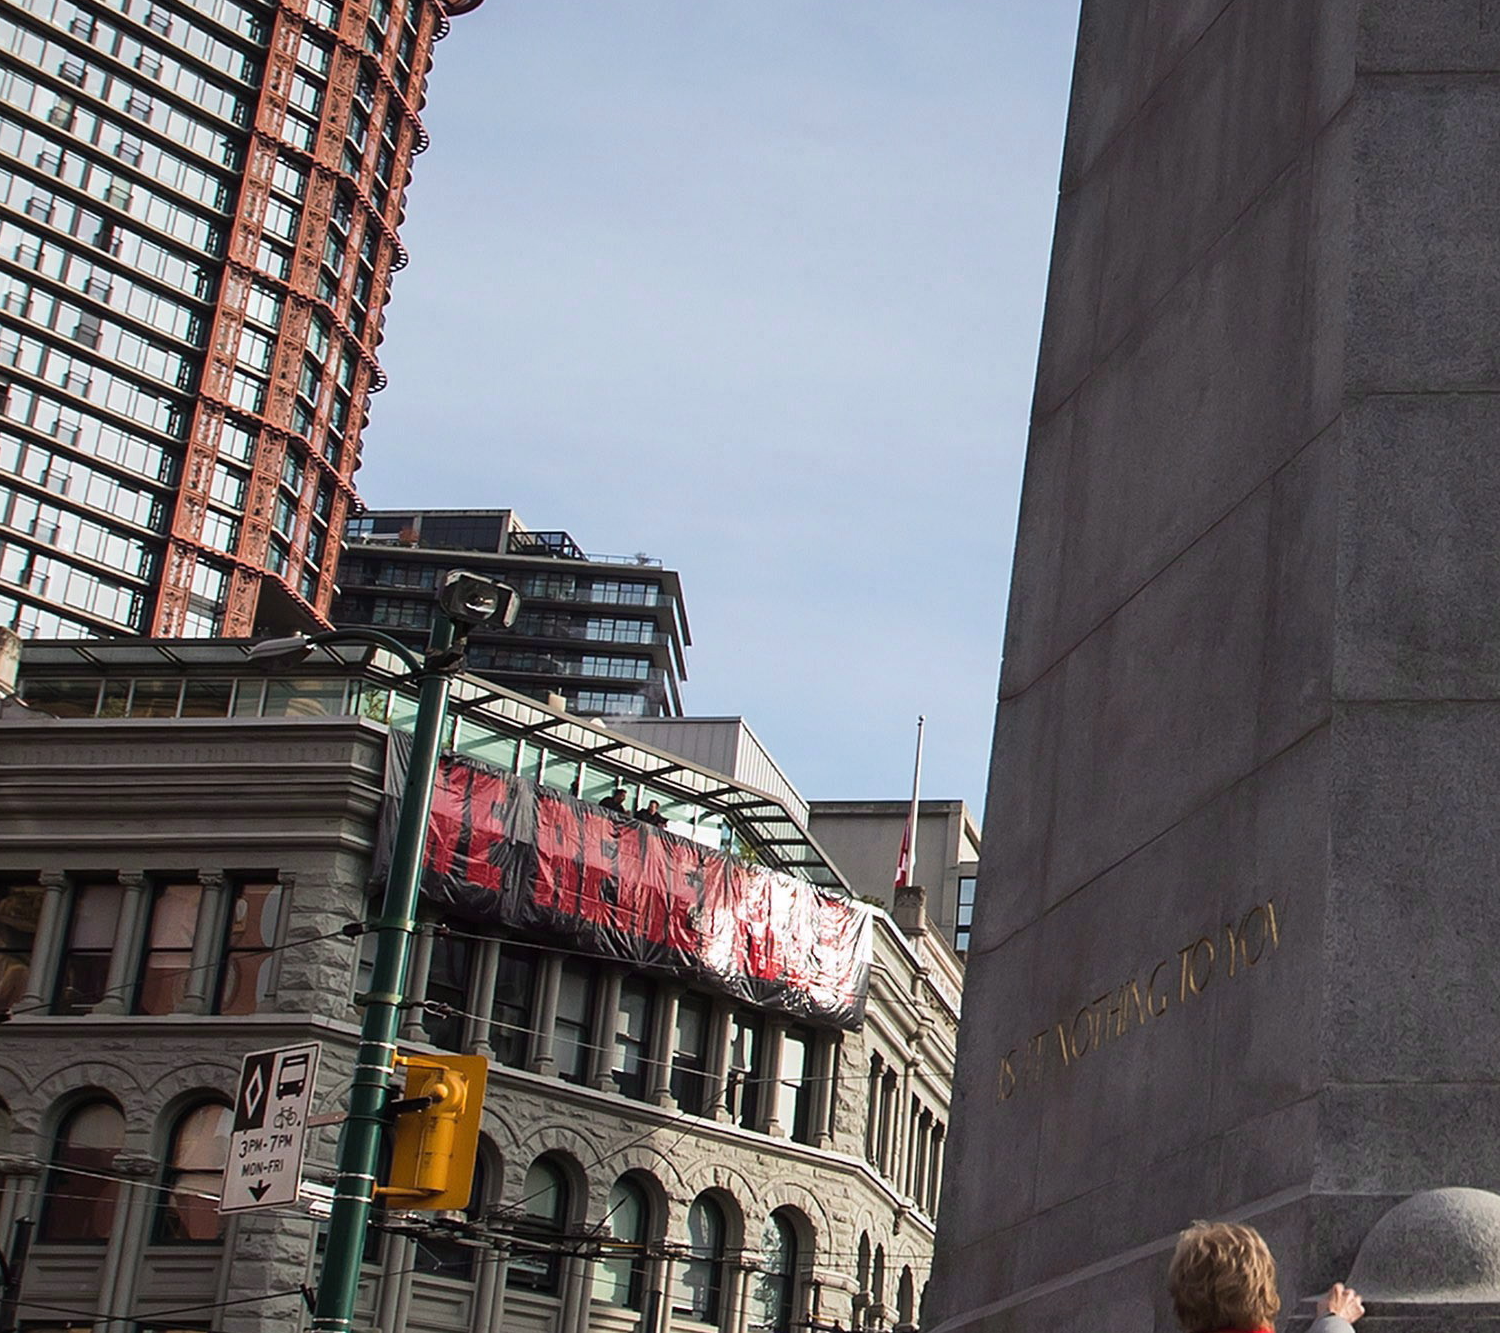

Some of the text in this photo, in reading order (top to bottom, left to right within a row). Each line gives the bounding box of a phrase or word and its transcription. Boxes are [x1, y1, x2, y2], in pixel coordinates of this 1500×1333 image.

[996, 1049, 1017, 1105] IS
[1057, 960, 1168, 1067] NOTHING
[1177, 937, 1215, 1003] TO
[241, 1158, 285, 1178] MON-FRI
